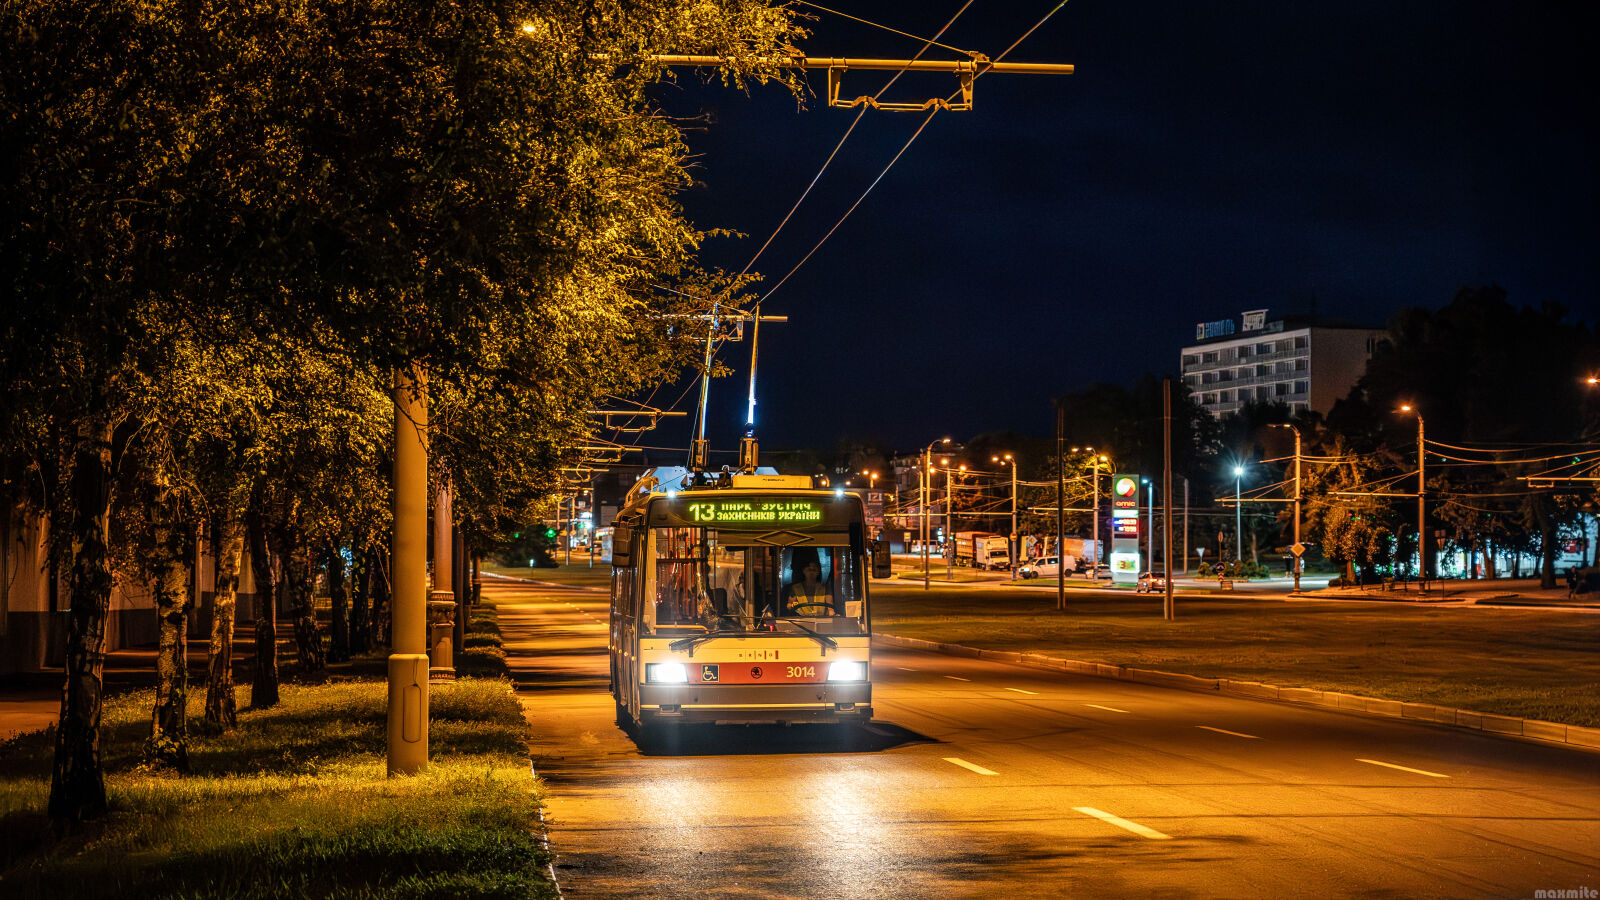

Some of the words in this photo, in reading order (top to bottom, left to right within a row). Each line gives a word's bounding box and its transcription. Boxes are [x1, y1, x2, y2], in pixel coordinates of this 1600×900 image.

[689, 503, 715, 521] 13
[716, 512, 775, 521] ЗАХИСНИКІВ
[778, 510, 820, 520] УКРАЇНИ
[786, 666, 816, 678] 3014
